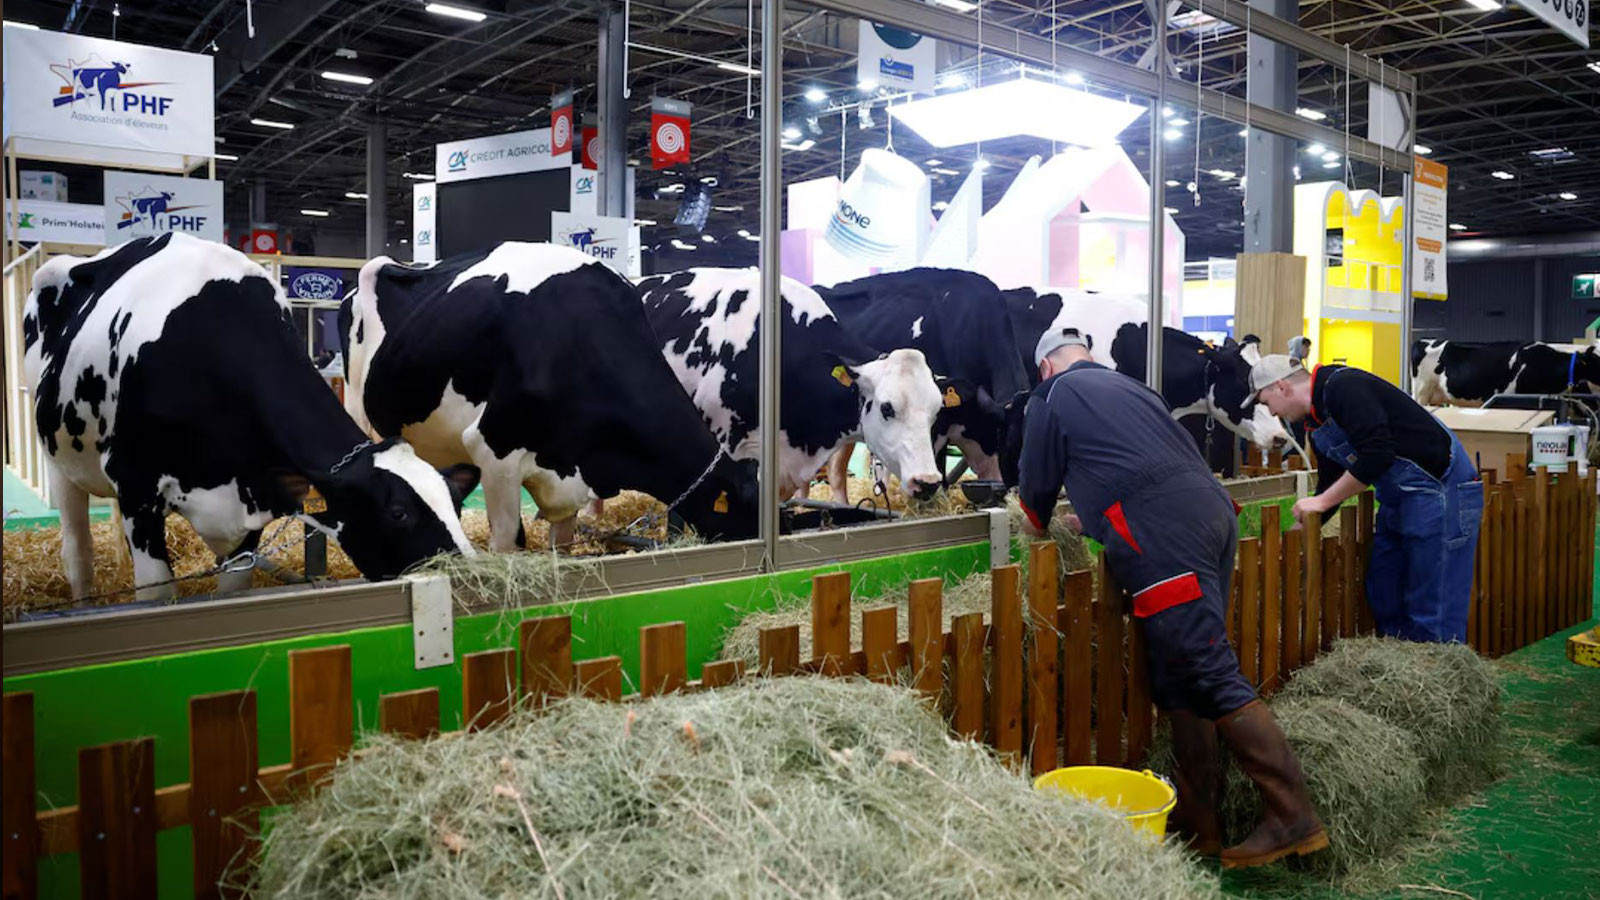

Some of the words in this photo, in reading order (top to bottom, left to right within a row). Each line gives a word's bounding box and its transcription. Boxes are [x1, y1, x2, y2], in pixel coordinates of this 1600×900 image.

[123, 92, 174, 116] PHF
[71, 111, 122, 125] Association
[506, 144, 551, 159] AGRICOL
[42, 218, 105, 230] Prim'Holstei
[169, 215, 207, 231] PHF
[592, 245, 617, 259] PHF
